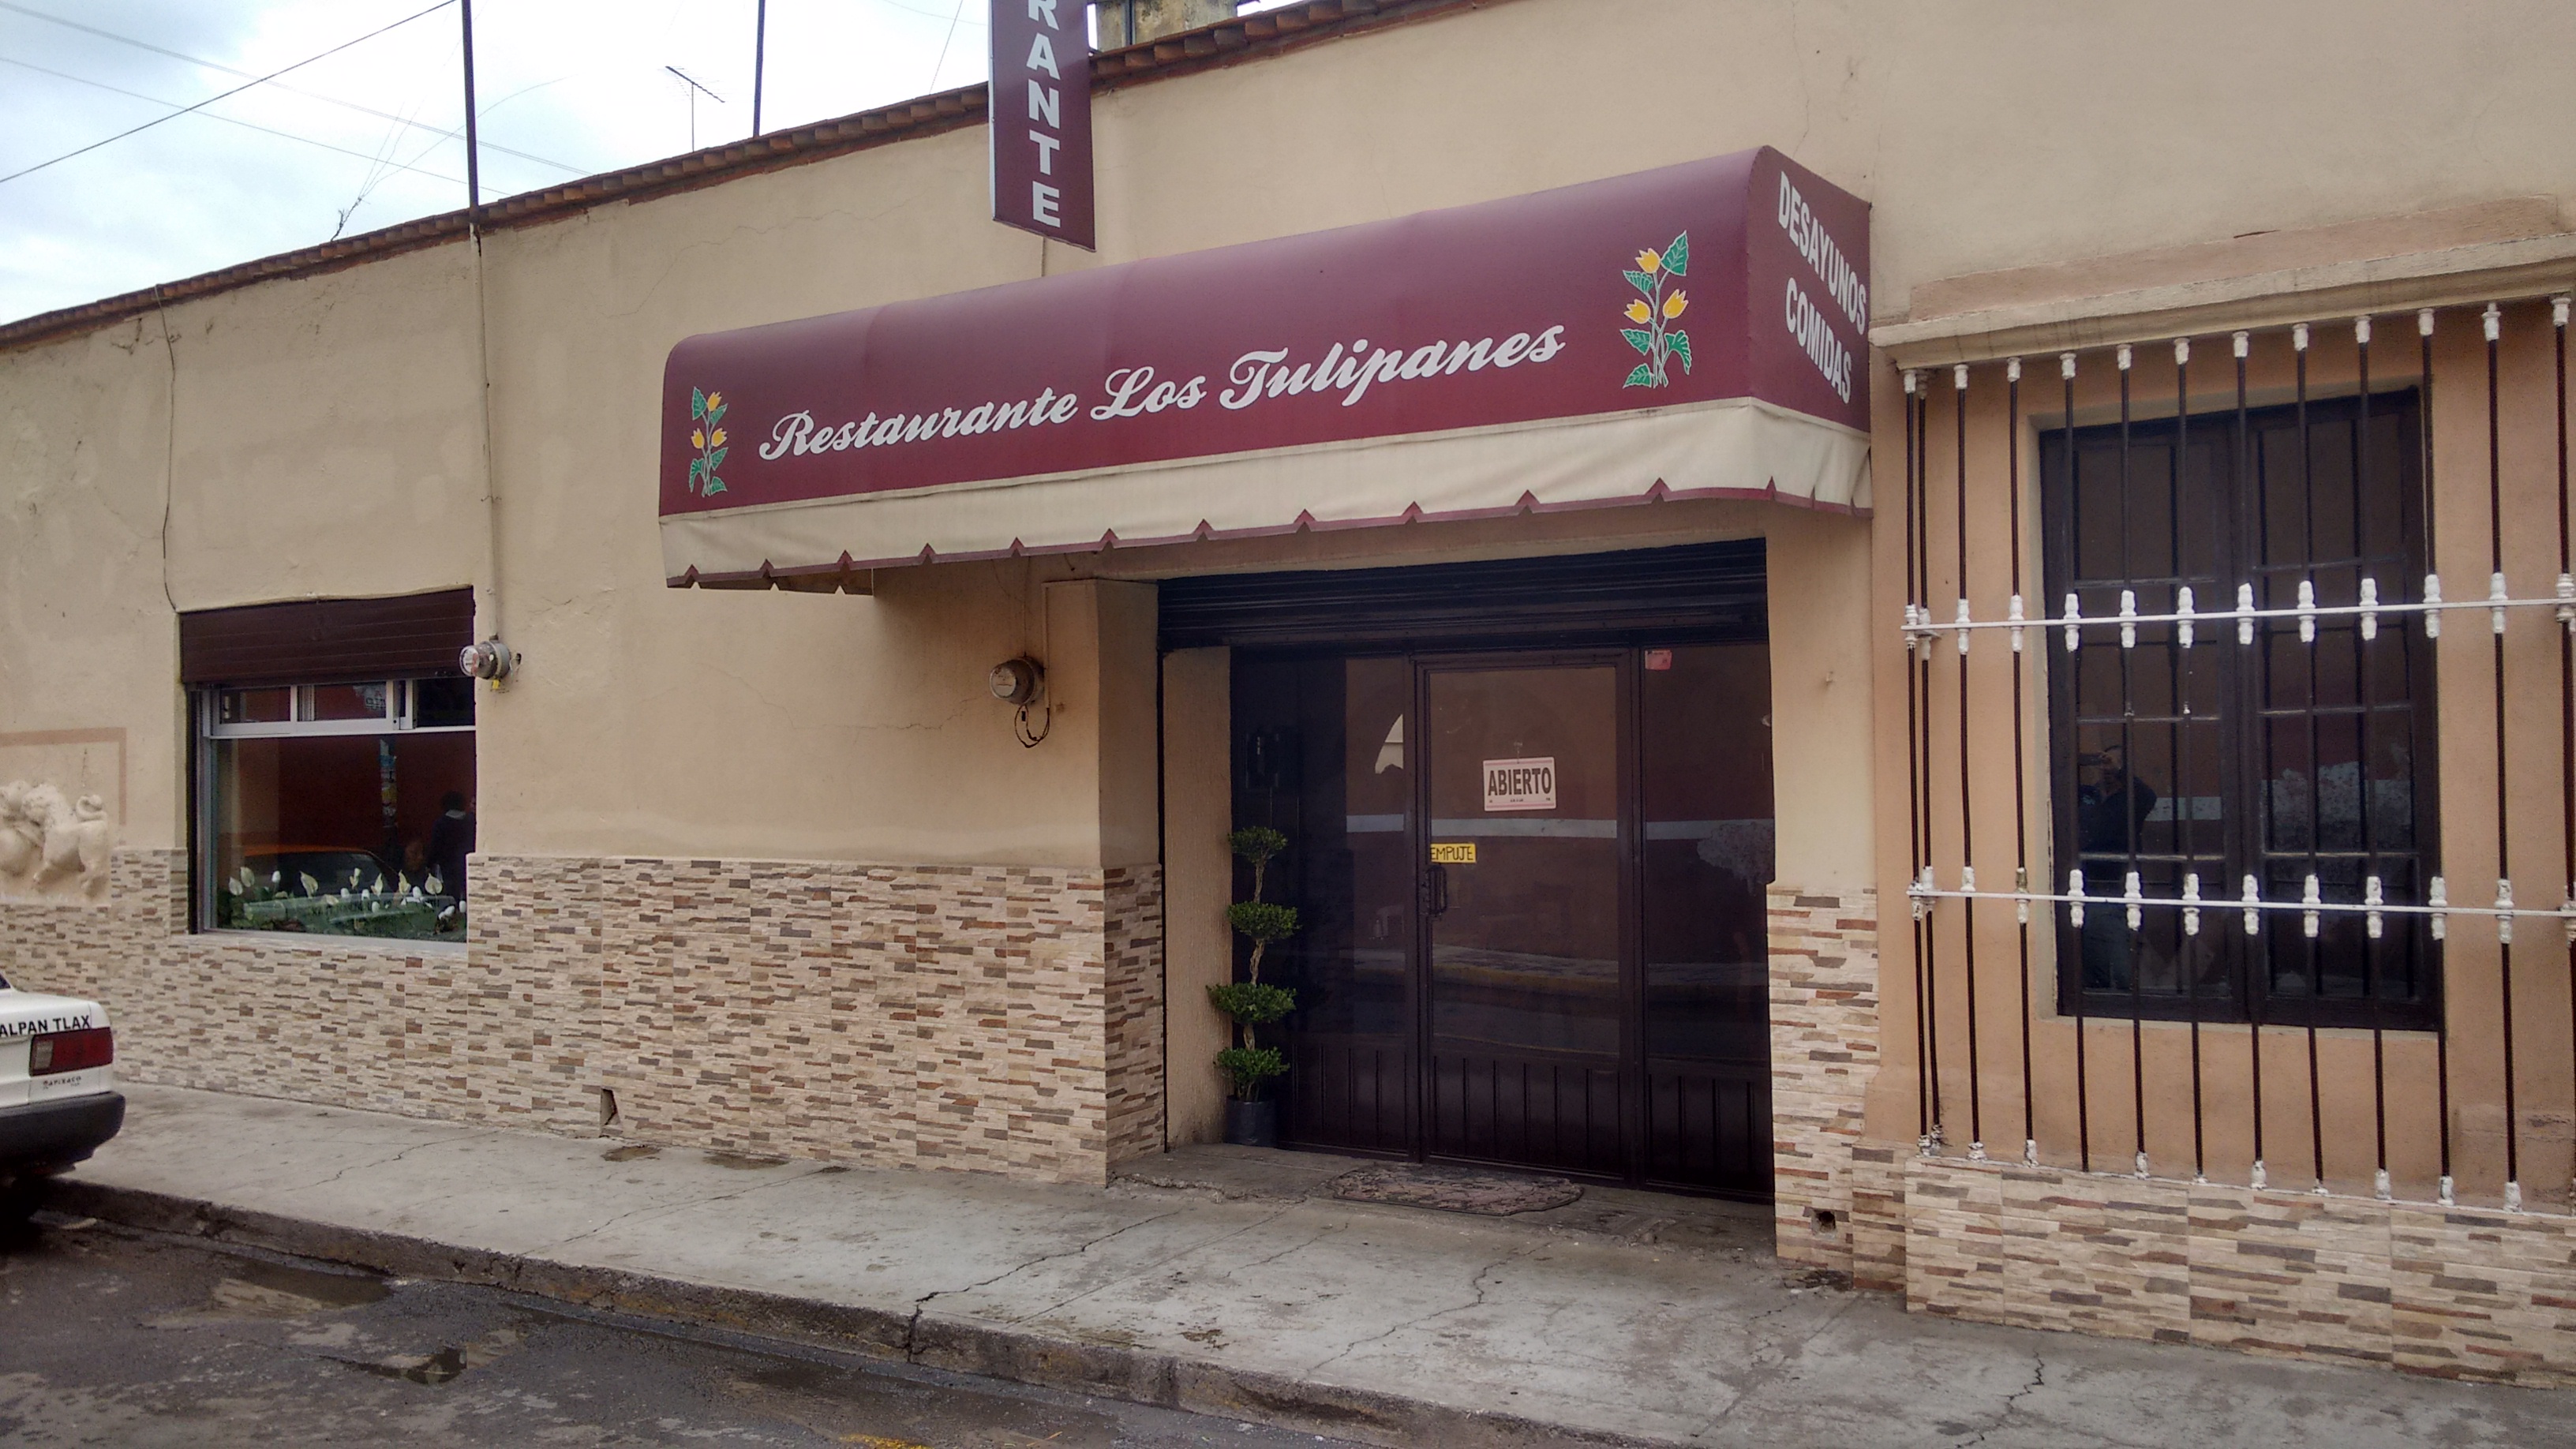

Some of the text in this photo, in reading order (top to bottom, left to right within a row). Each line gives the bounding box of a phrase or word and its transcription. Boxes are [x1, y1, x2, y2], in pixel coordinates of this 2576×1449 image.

[1778, 170, 1866, 335] DESAYUNOS
[1785, 277, 1852, 404] COMIDAS
[758, 325, 1567, 460] Restaurante Los Tulipanes
[1488, 767, 1552, 796] ABIERTO
[1429, 846, 1473, 861] EMPUJE
[52, 1015, 90, 1032] TLAX
